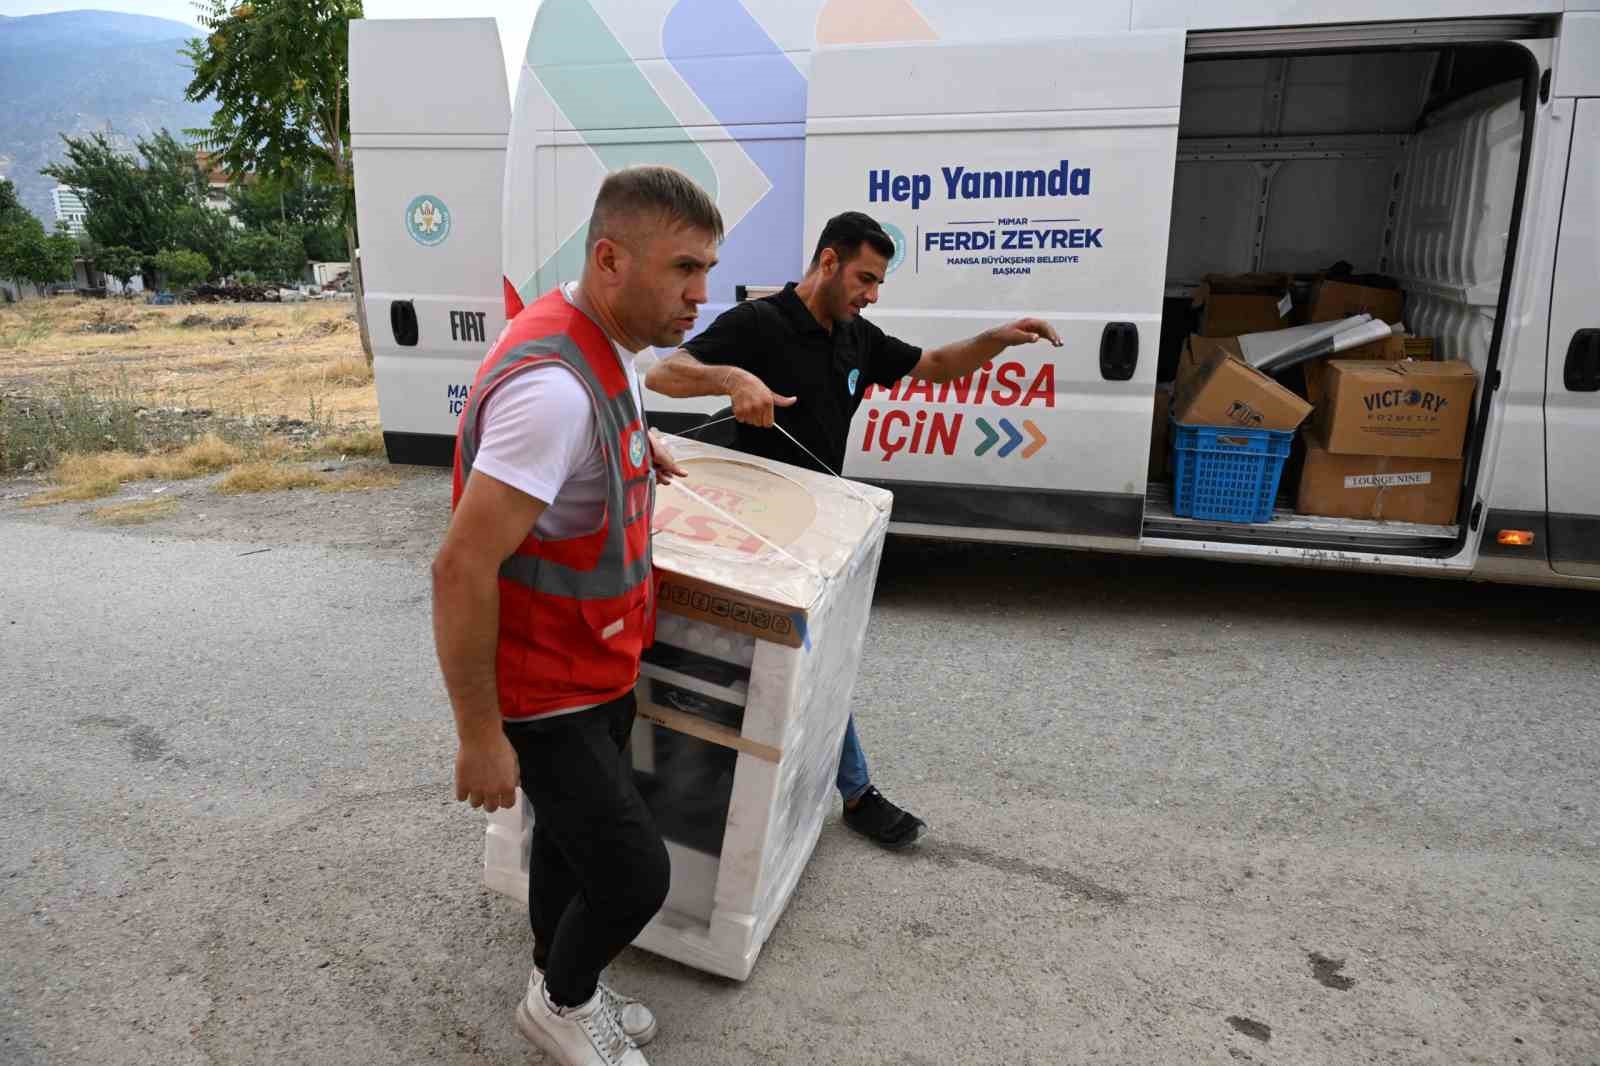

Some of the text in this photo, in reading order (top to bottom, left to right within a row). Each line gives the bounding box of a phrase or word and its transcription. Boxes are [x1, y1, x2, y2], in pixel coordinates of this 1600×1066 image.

[869, 160, 1091, 209] Hep Yanımda
[1001, 228, 1104, 250] ZEYREK
[449, 310, 486, 342] FIAT
[447, 384, 472, 399] MA
[449, 400, 466, 416] İÇ
